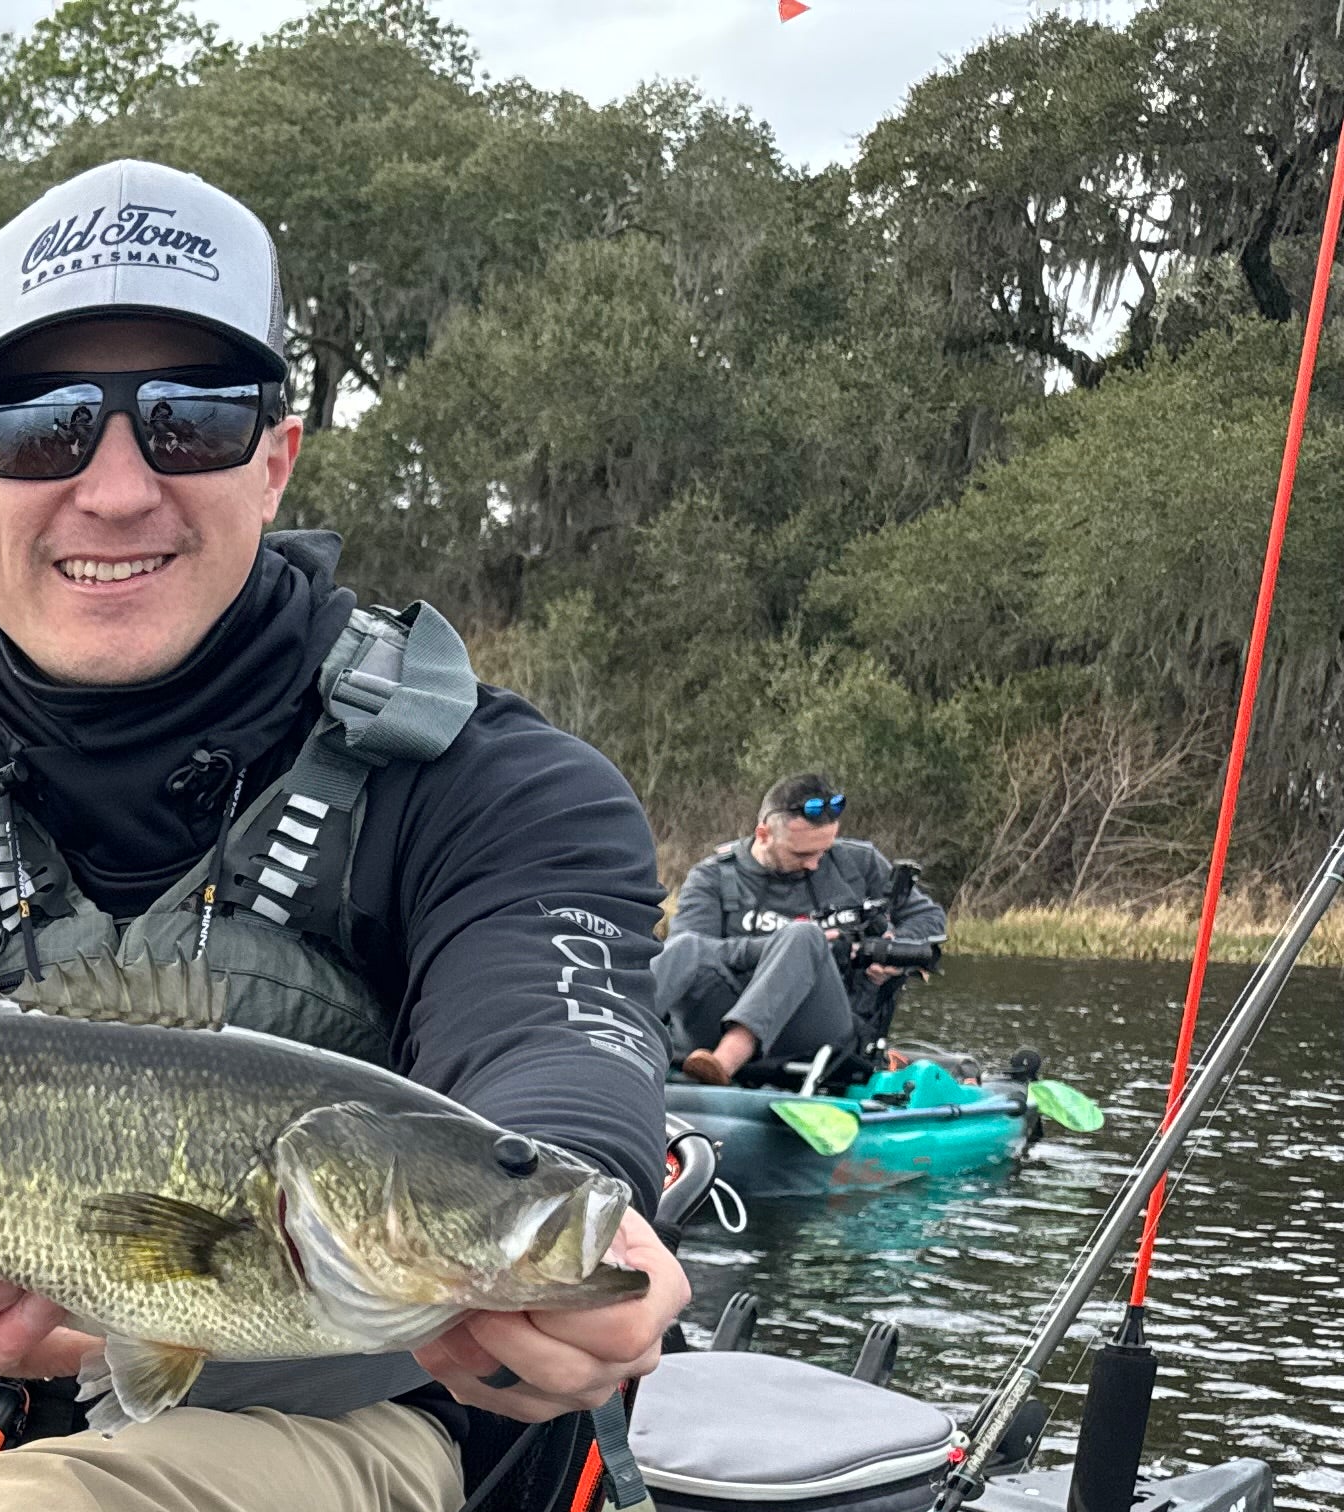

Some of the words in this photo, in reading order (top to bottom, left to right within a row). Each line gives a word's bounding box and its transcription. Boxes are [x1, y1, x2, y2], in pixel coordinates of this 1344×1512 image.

[21, 206, 107, 275] Old
[100, 203, 218, 260] Town
[21, 250, 178, 291] SPORTSMAN
